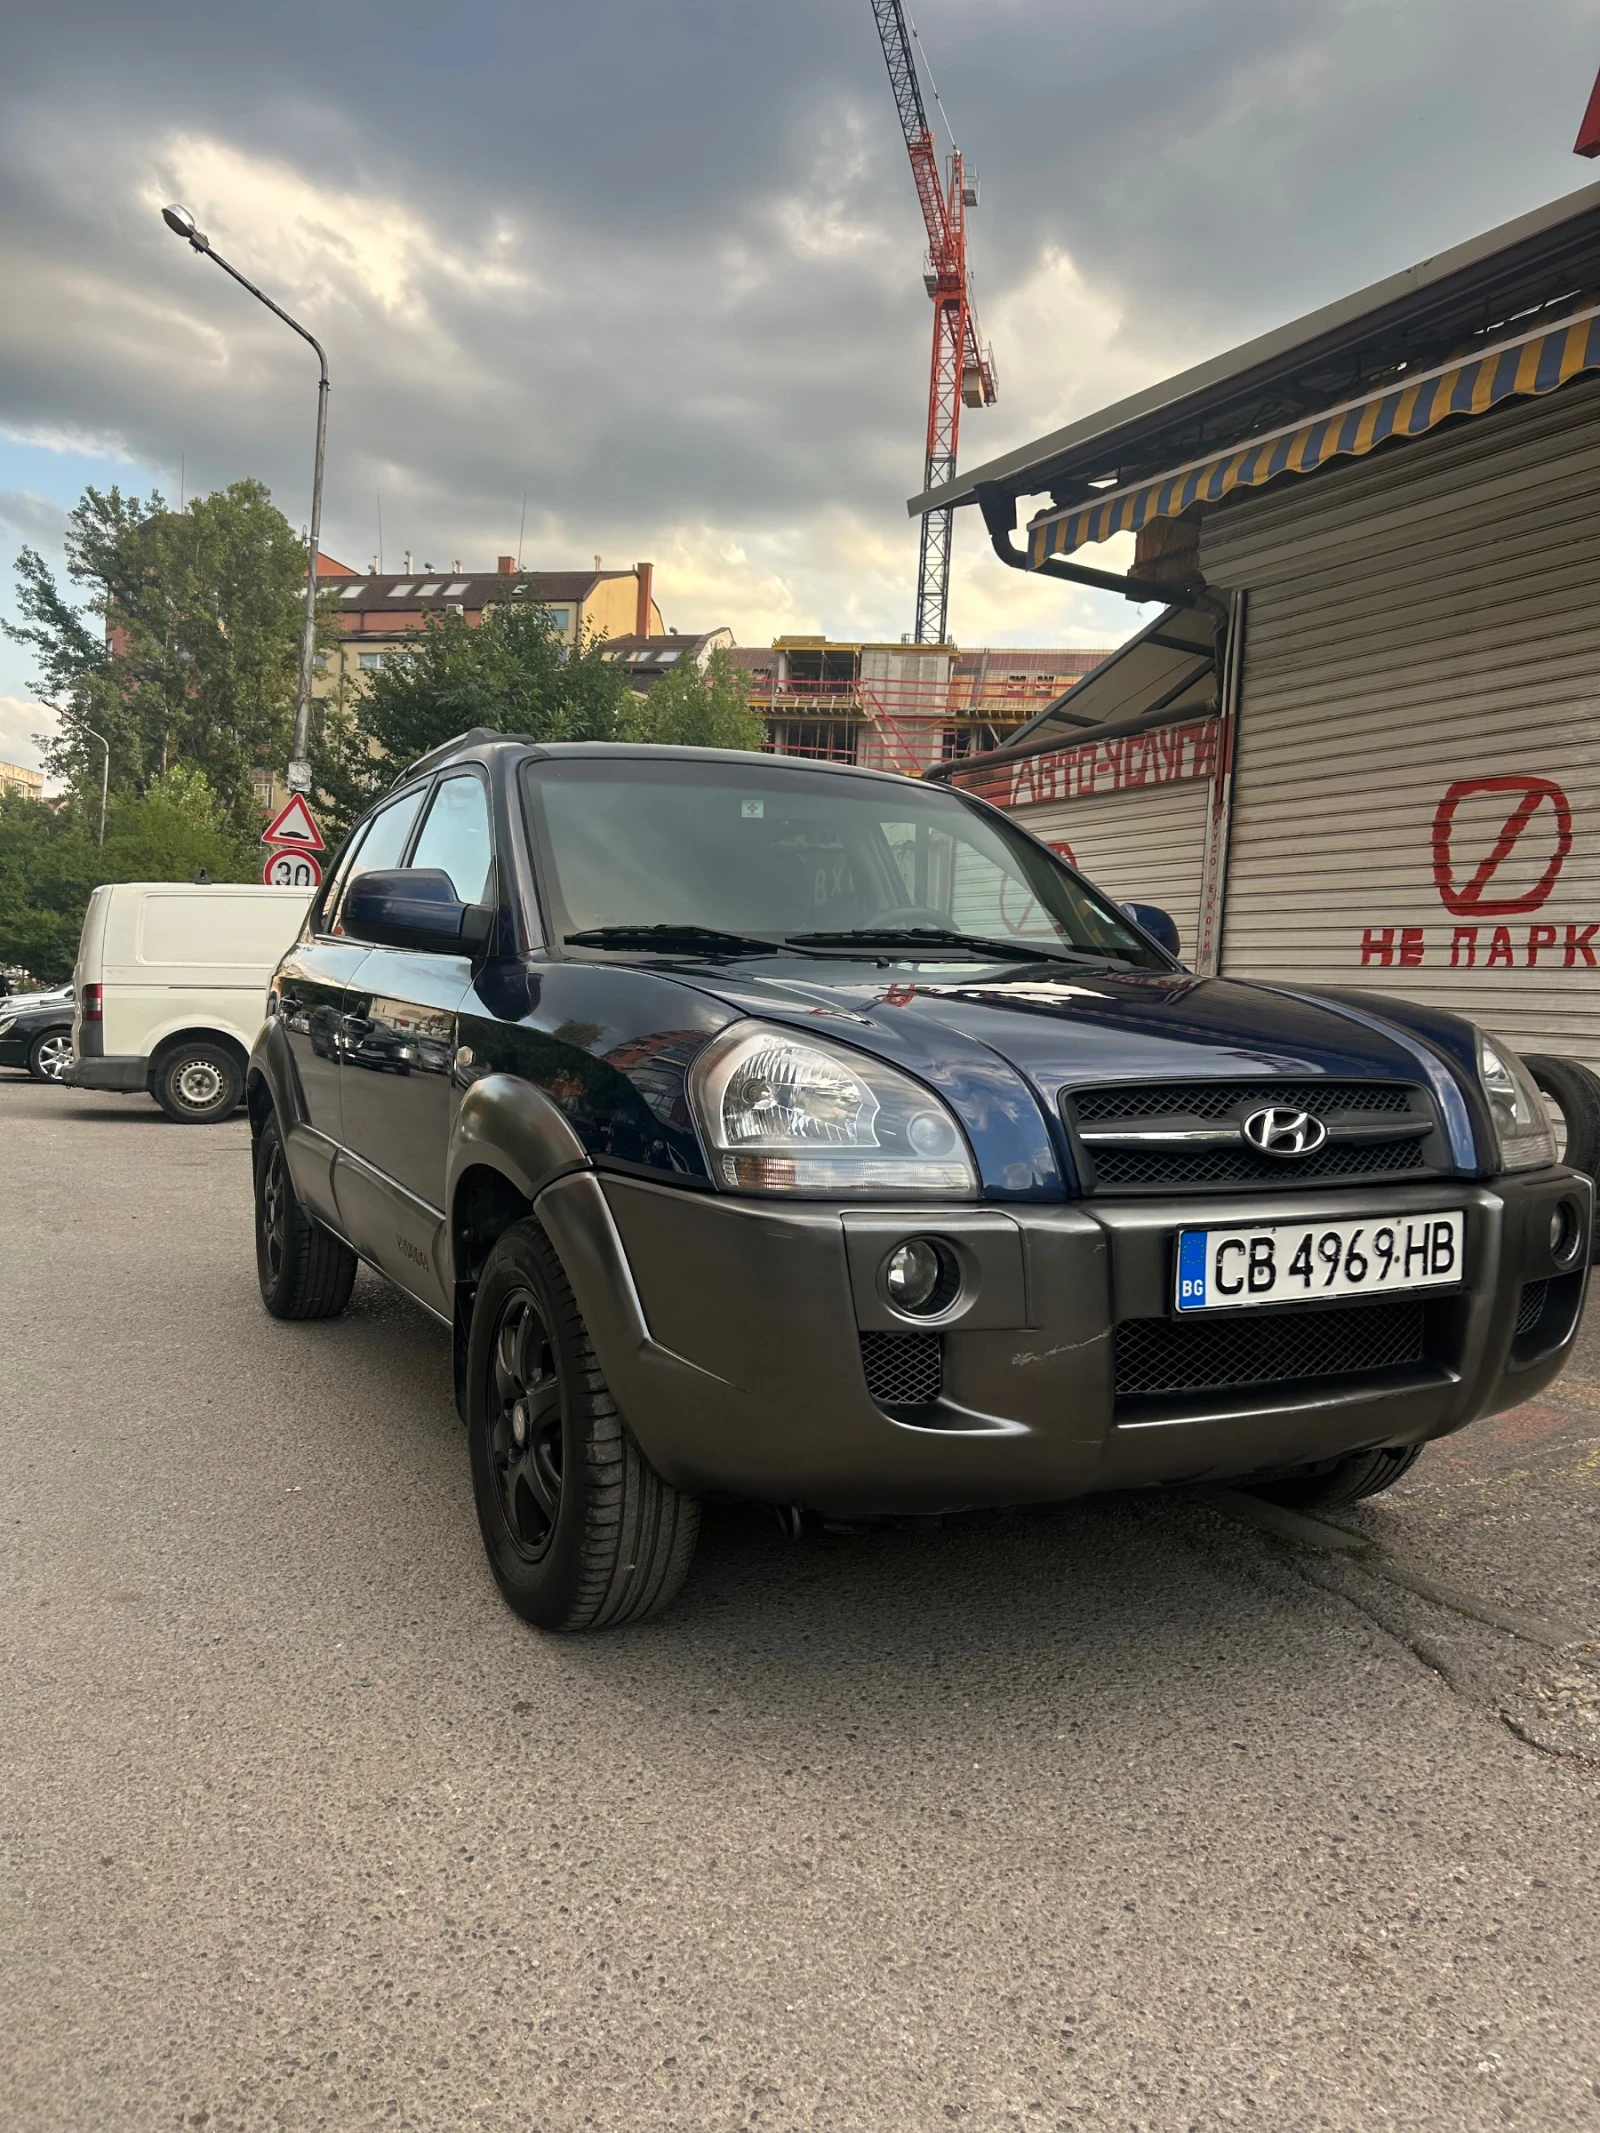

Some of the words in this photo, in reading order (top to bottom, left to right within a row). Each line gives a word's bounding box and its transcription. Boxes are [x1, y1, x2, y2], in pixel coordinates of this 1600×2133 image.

[276, 861, 311, 886] 30
[1360, 927, 1425, 967] НЕ
[1448, 924, 1600, 967] ПАРК
[1181, 1280, 1204, 1297] BG
[1215, 1236, 1277, 1295] CB
[1288, 1226, 1396, 1288] 4969
[1404, 1220, 1455, 1278] HB
